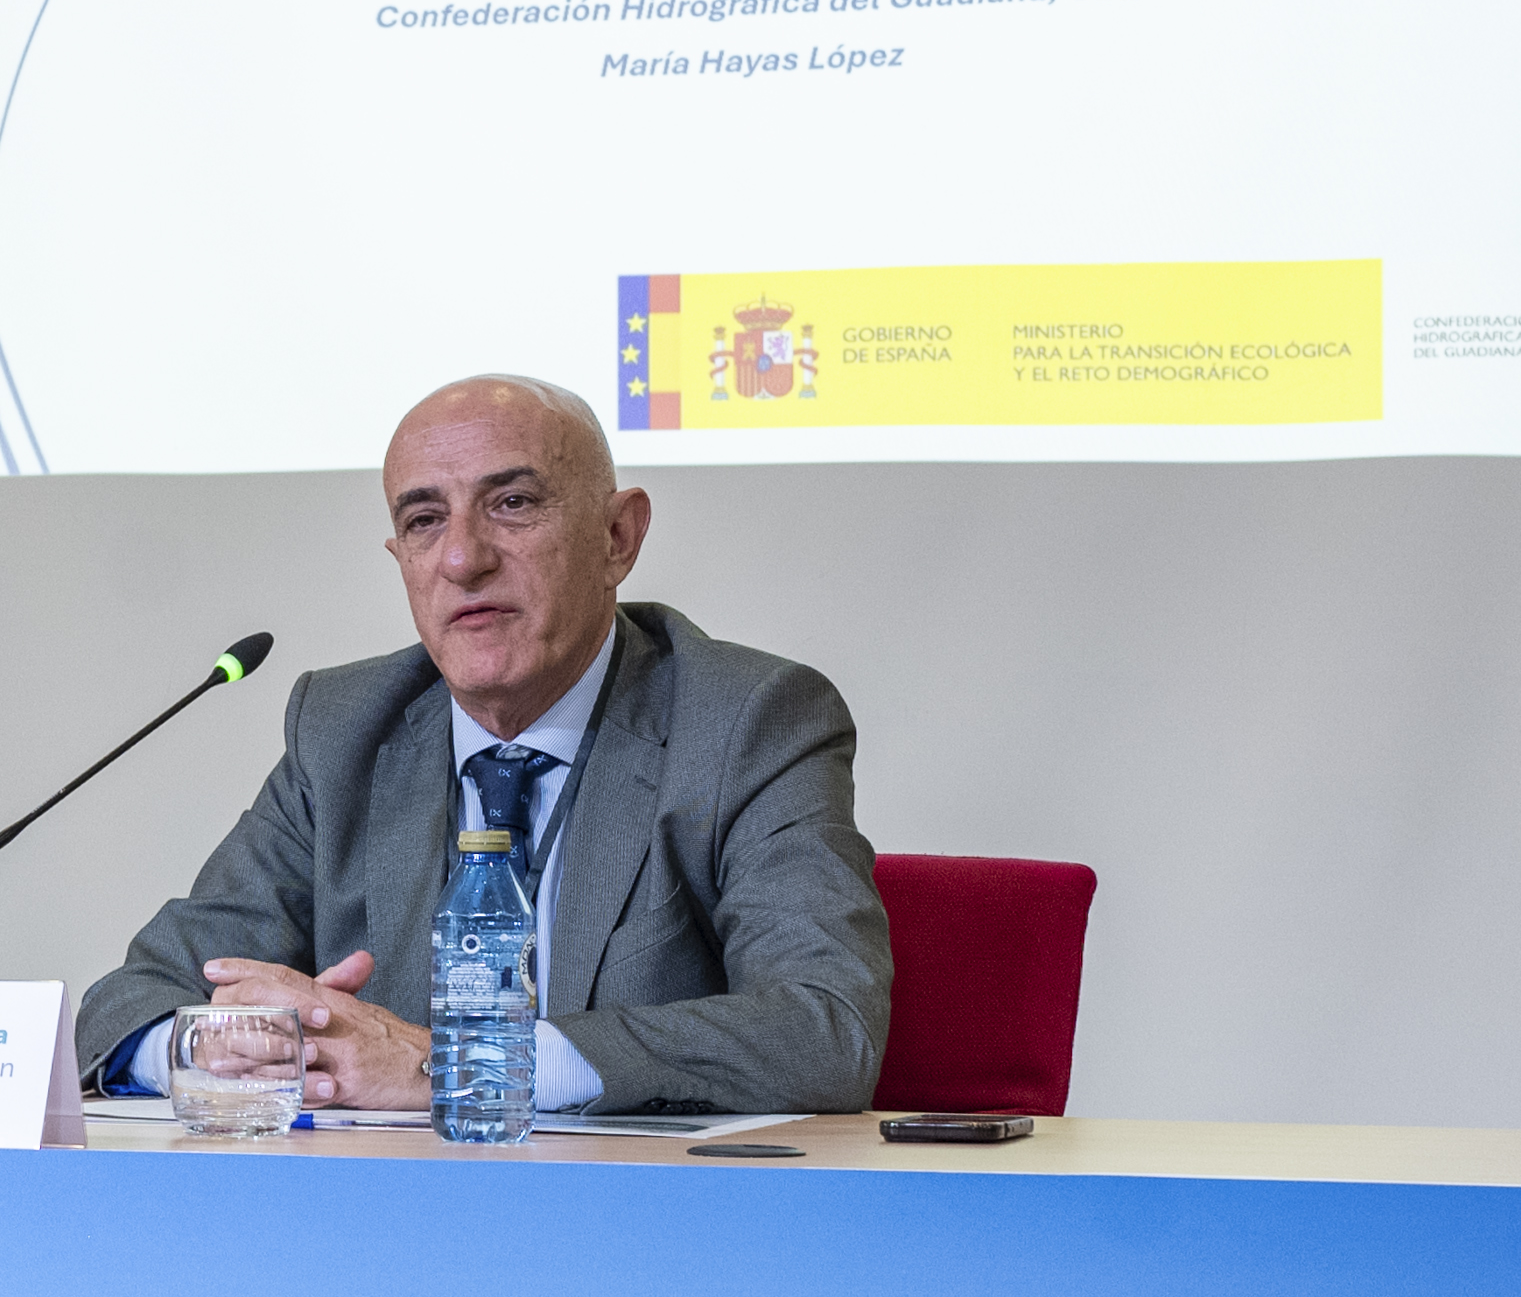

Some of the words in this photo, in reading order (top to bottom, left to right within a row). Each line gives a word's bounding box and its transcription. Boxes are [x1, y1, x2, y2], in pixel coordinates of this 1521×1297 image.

[842, 325, 953, 343] GOBIERNO
[843, 348, 869, 364] DE
[876, 343, 952, 363] ESPAÑA
